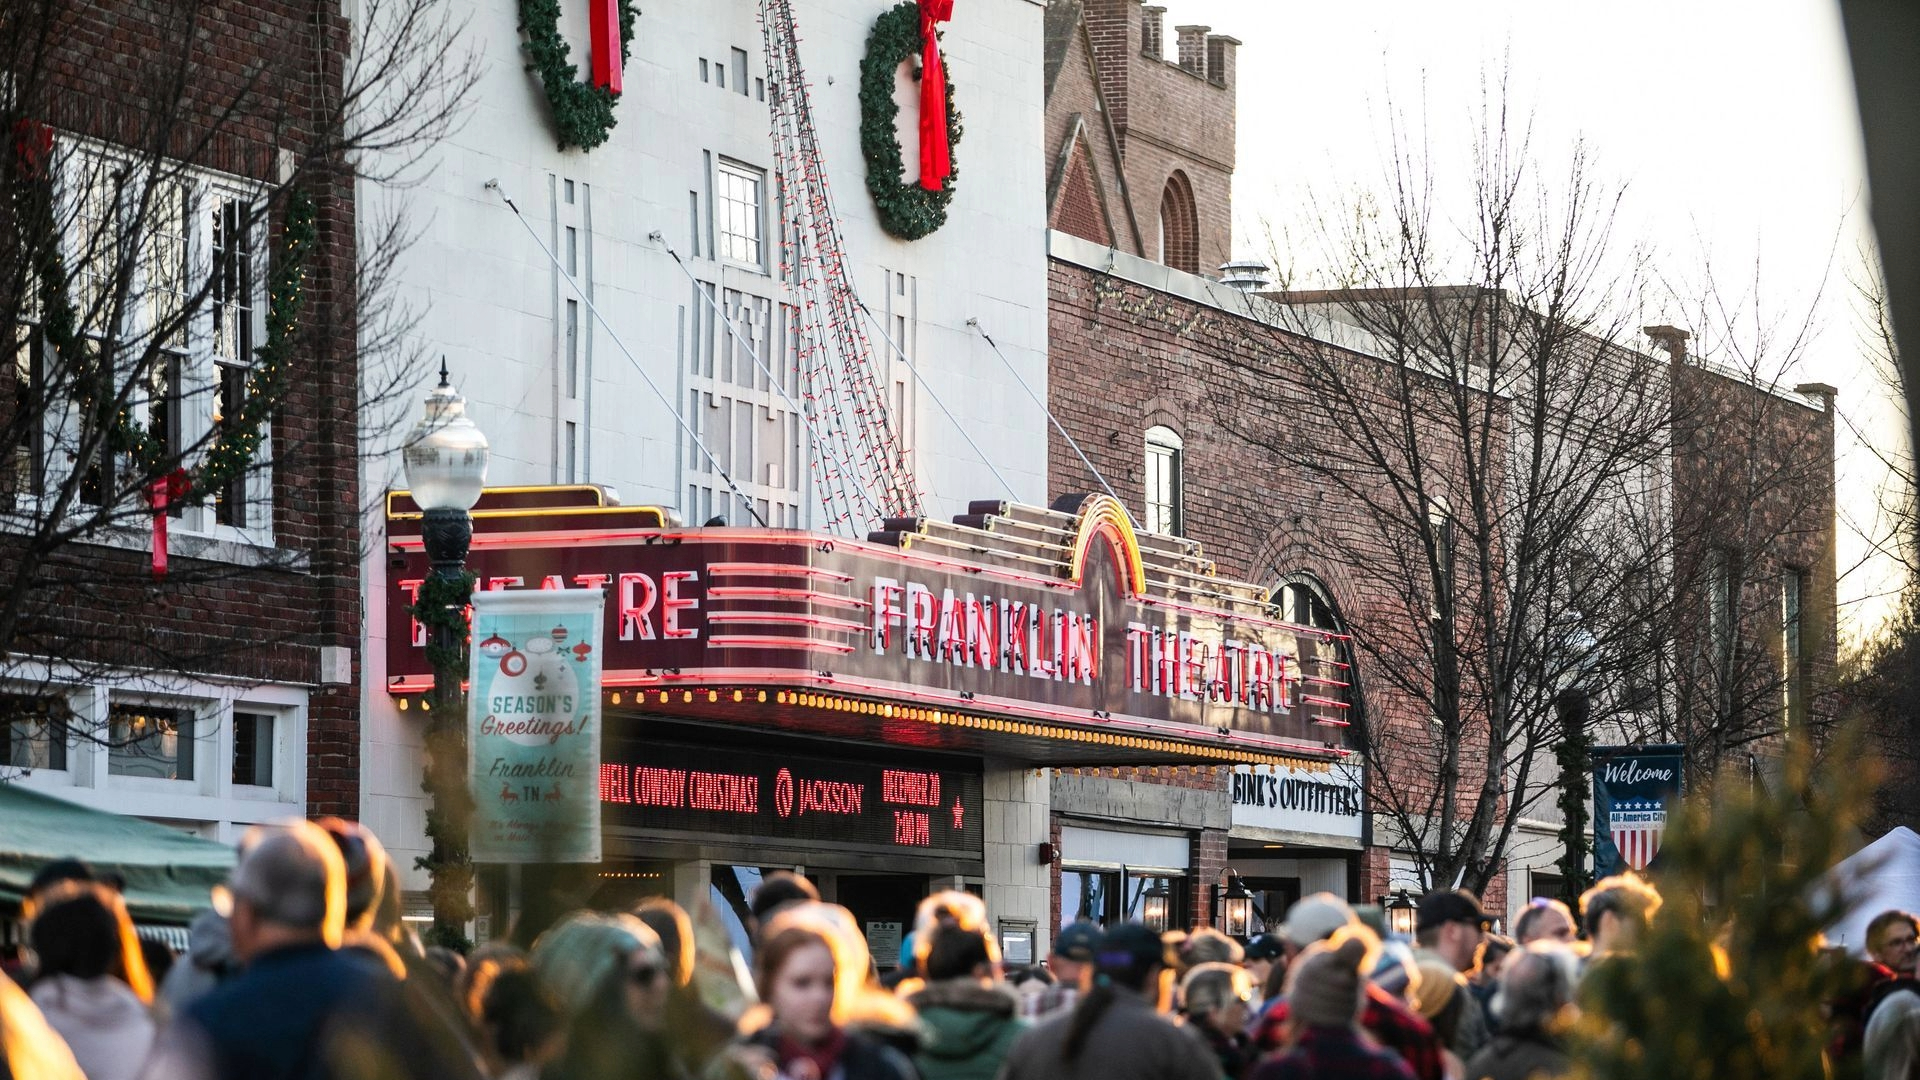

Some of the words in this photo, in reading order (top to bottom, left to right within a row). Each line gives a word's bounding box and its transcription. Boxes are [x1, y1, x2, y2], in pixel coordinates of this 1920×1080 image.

[872, 576, 1098, 686] FRANKLIN
[1121, 621, 1298, 715] THEATRE
[493, 695, 573, 714] SEASON'S
[480, 714, 588, 745] Greetings!
[488, 756, 575, 778] Franklin
[1604, 759, 1673, 785] Welcome
[524, 786, 540, 801] TN
[634, 766, 686, 807] COWBOY
[689, 771, 758, 813] CHRISTMAS!
[883, 769, 928, 805] DECEMBER
[929, 772, 940, 806] 20
[1233, 773, 1277, 808] BINK'S
[1280, 777, 1359, 817] OUTFITTERS
[894, 811, 914, 845] 7:00
[916, 812, 929, 846] PM
[1611, 813, 1651, 822] All-America
[1652, 812, 1666, 823] City
